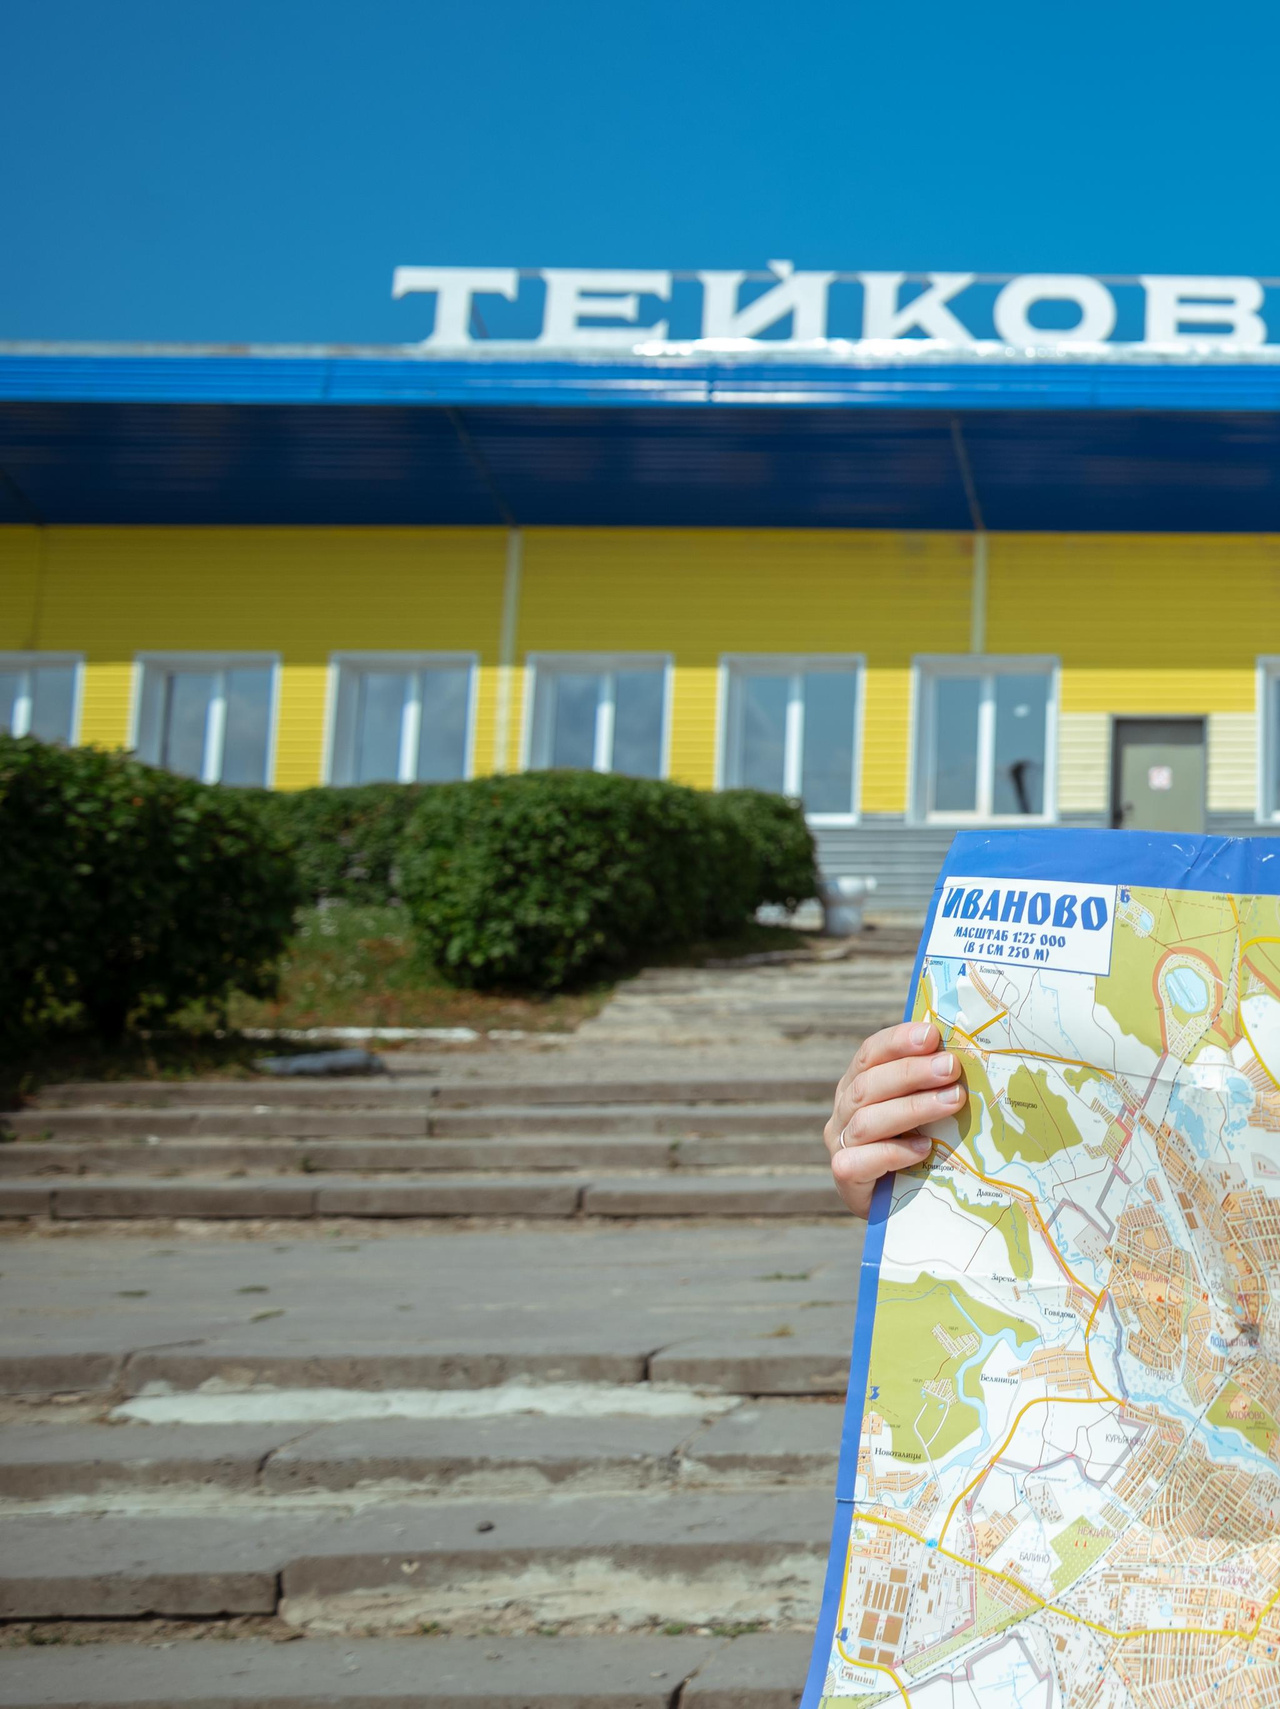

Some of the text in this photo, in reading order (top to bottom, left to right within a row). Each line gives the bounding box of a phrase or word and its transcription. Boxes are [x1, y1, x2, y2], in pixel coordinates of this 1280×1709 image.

[941, 887, 1109, 931] ИВАНОВО
[954, 925, 1066, 948] МАСШТАБ 1:25 000
[963, 941, 1050, 962] (В 1 СМ 250 М)
[922, 966, 928, 978] 1
[957, 963, 967, 976] А
[980, 1373, 1020, 1386] Беляницы
[874, 1447, 922, 1461] Новоталицы
[1019, 1551, 1050, 1564] БАЛИНО
